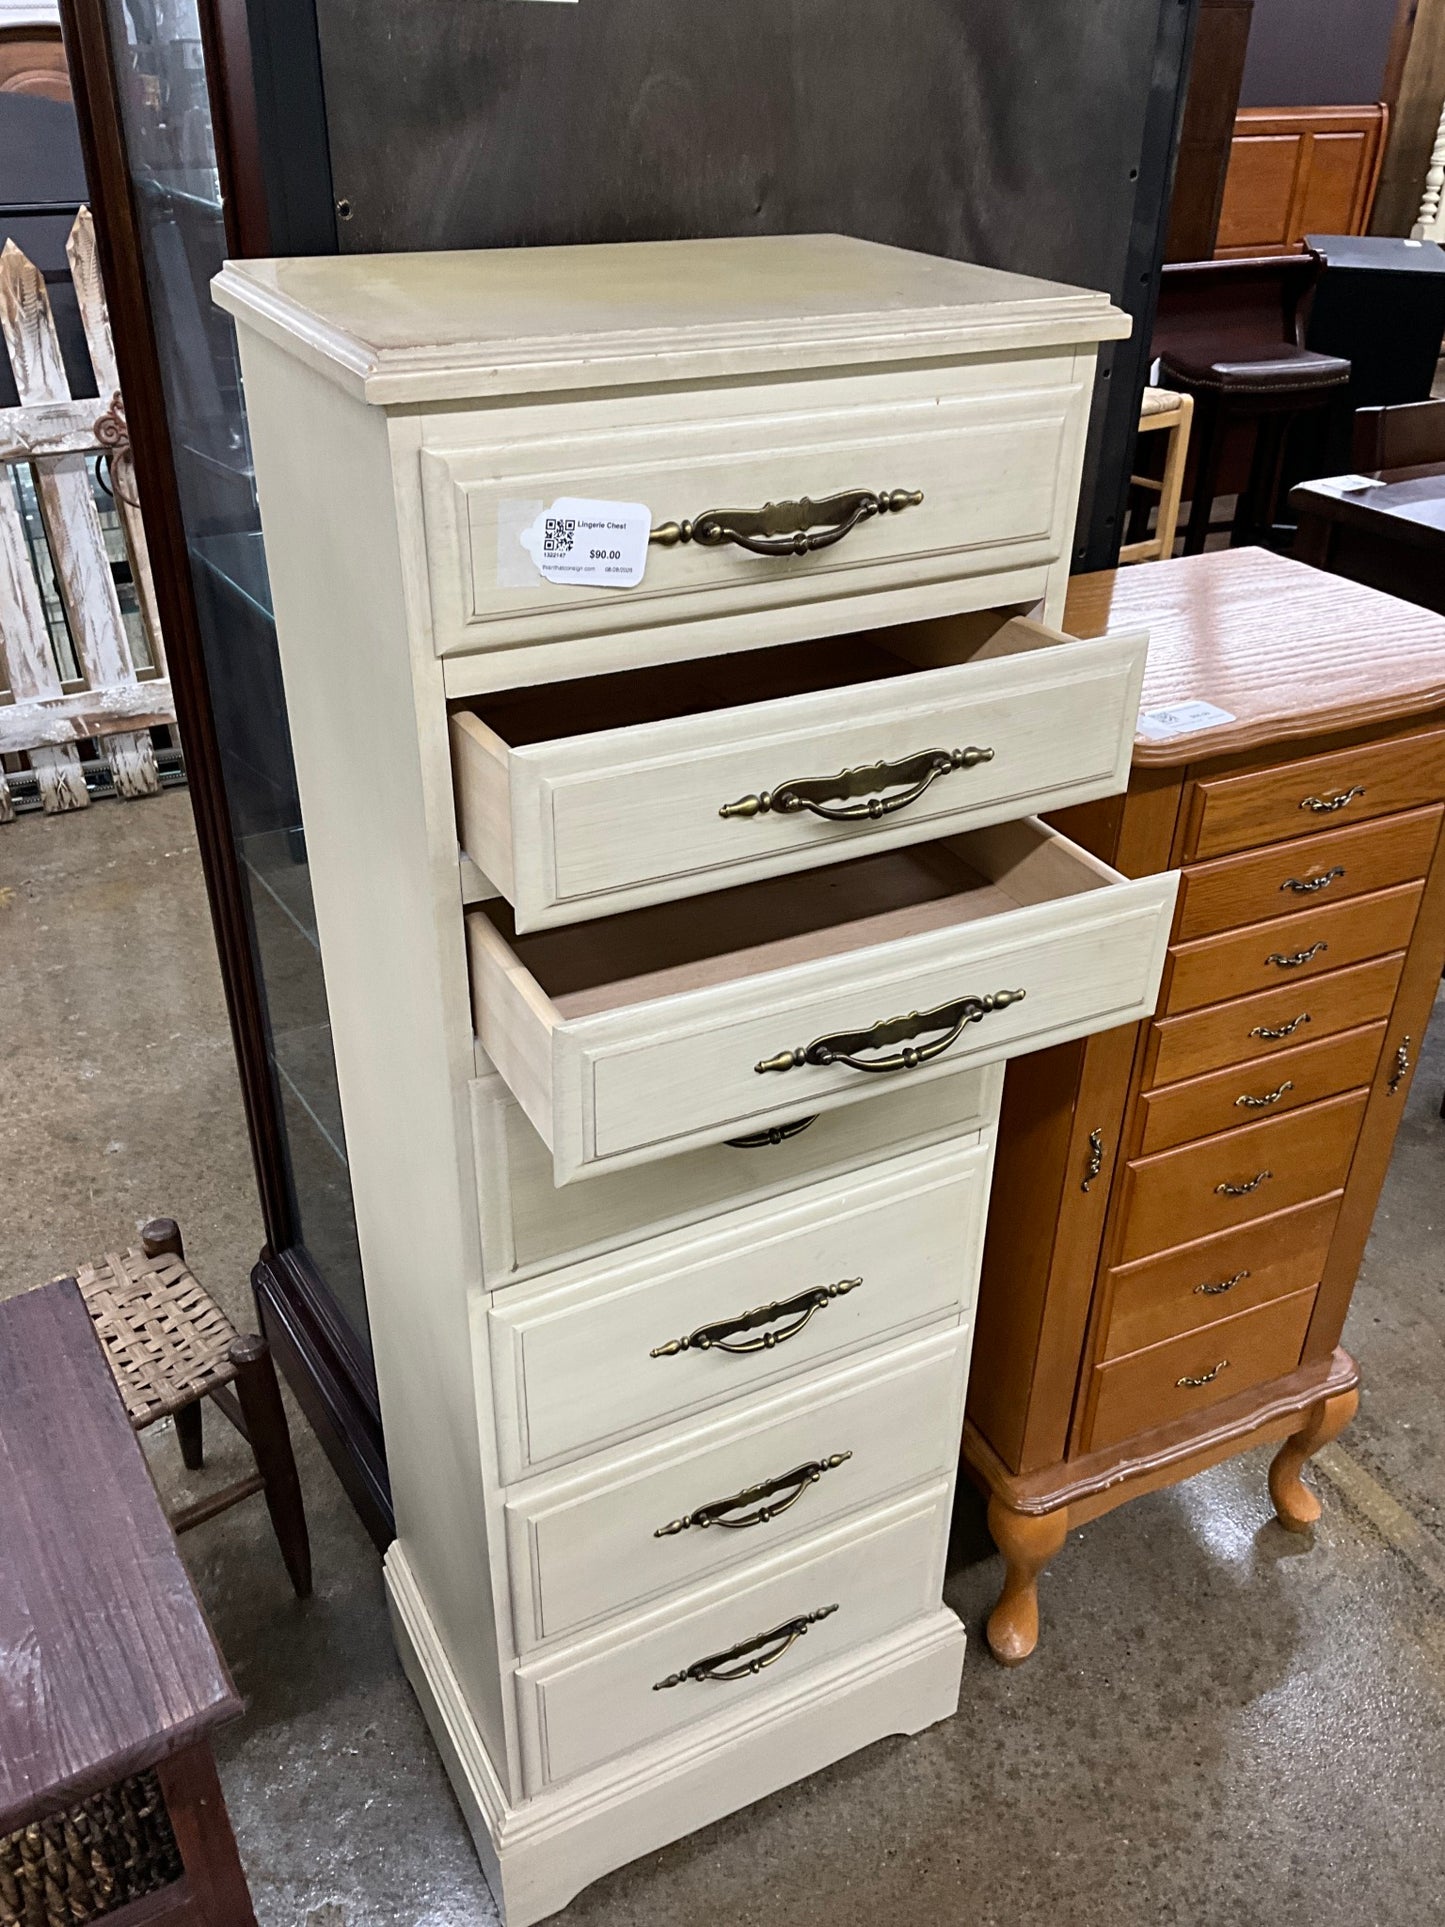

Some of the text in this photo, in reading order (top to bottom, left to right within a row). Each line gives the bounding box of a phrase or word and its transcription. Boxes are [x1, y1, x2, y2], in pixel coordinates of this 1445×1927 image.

[577, 521, 627, 530] Lingerie Chest
[589, 550, 621, 560] $90.00
